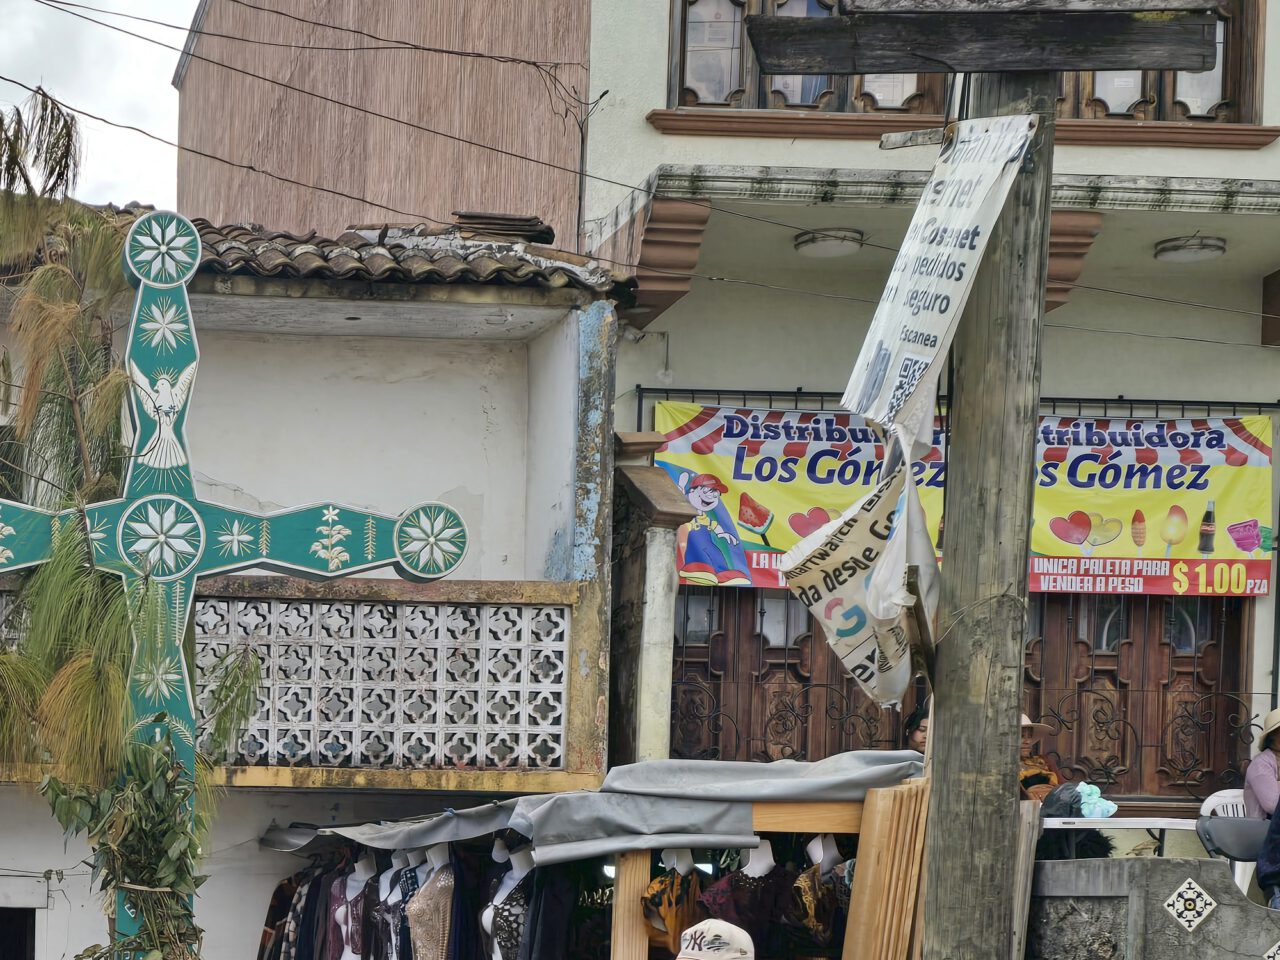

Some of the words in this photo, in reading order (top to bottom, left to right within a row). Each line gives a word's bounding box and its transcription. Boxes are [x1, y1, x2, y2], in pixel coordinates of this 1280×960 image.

[910, 252, 967, 282] pedidos
[903, 286, 951, 316] seguro
[899, 324, 938, 349] Escanea
[1037, 422, 1226, 449] tribuidora
[732, 445, 799, 484] Los
[1067, 450, 1211, 490] Gómez
[819, 545, 880, 593] desde
[1034, 558, 1077, 575] UNICA
[1079, 559, 1131, 575] PALETA
[1133, 560, 1170, 576] PARA
[1172, 561, 1190, 595] $
[1195, 563, 1247, 594] 1.00
[1246, 579, 1268, 594] PZA
[1040, 576, 1094, 591] VENDER
[1096, 577, 1106, 591] A
[1108, 577, 1144, 592] PESO
